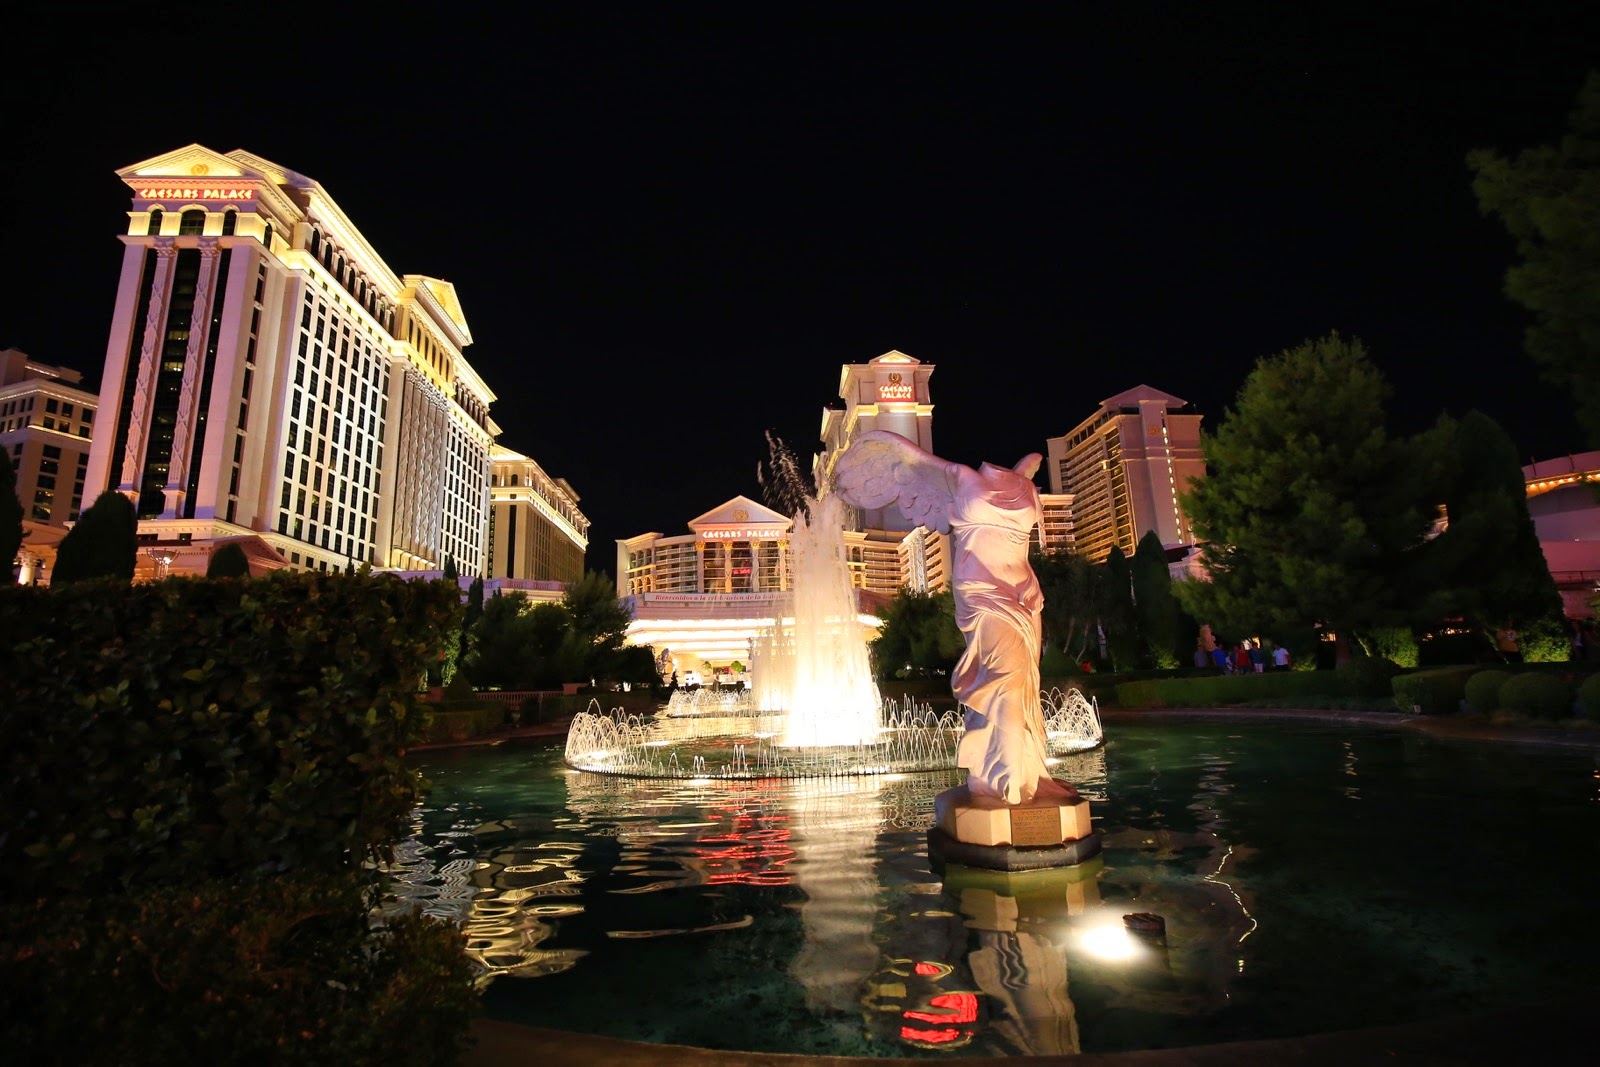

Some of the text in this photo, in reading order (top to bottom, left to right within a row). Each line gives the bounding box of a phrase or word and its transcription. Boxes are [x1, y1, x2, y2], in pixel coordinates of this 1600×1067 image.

[139, 188, 253, 199] CAESARS PALACE
[702, 530, 780, 539] CAESARS PALACE
